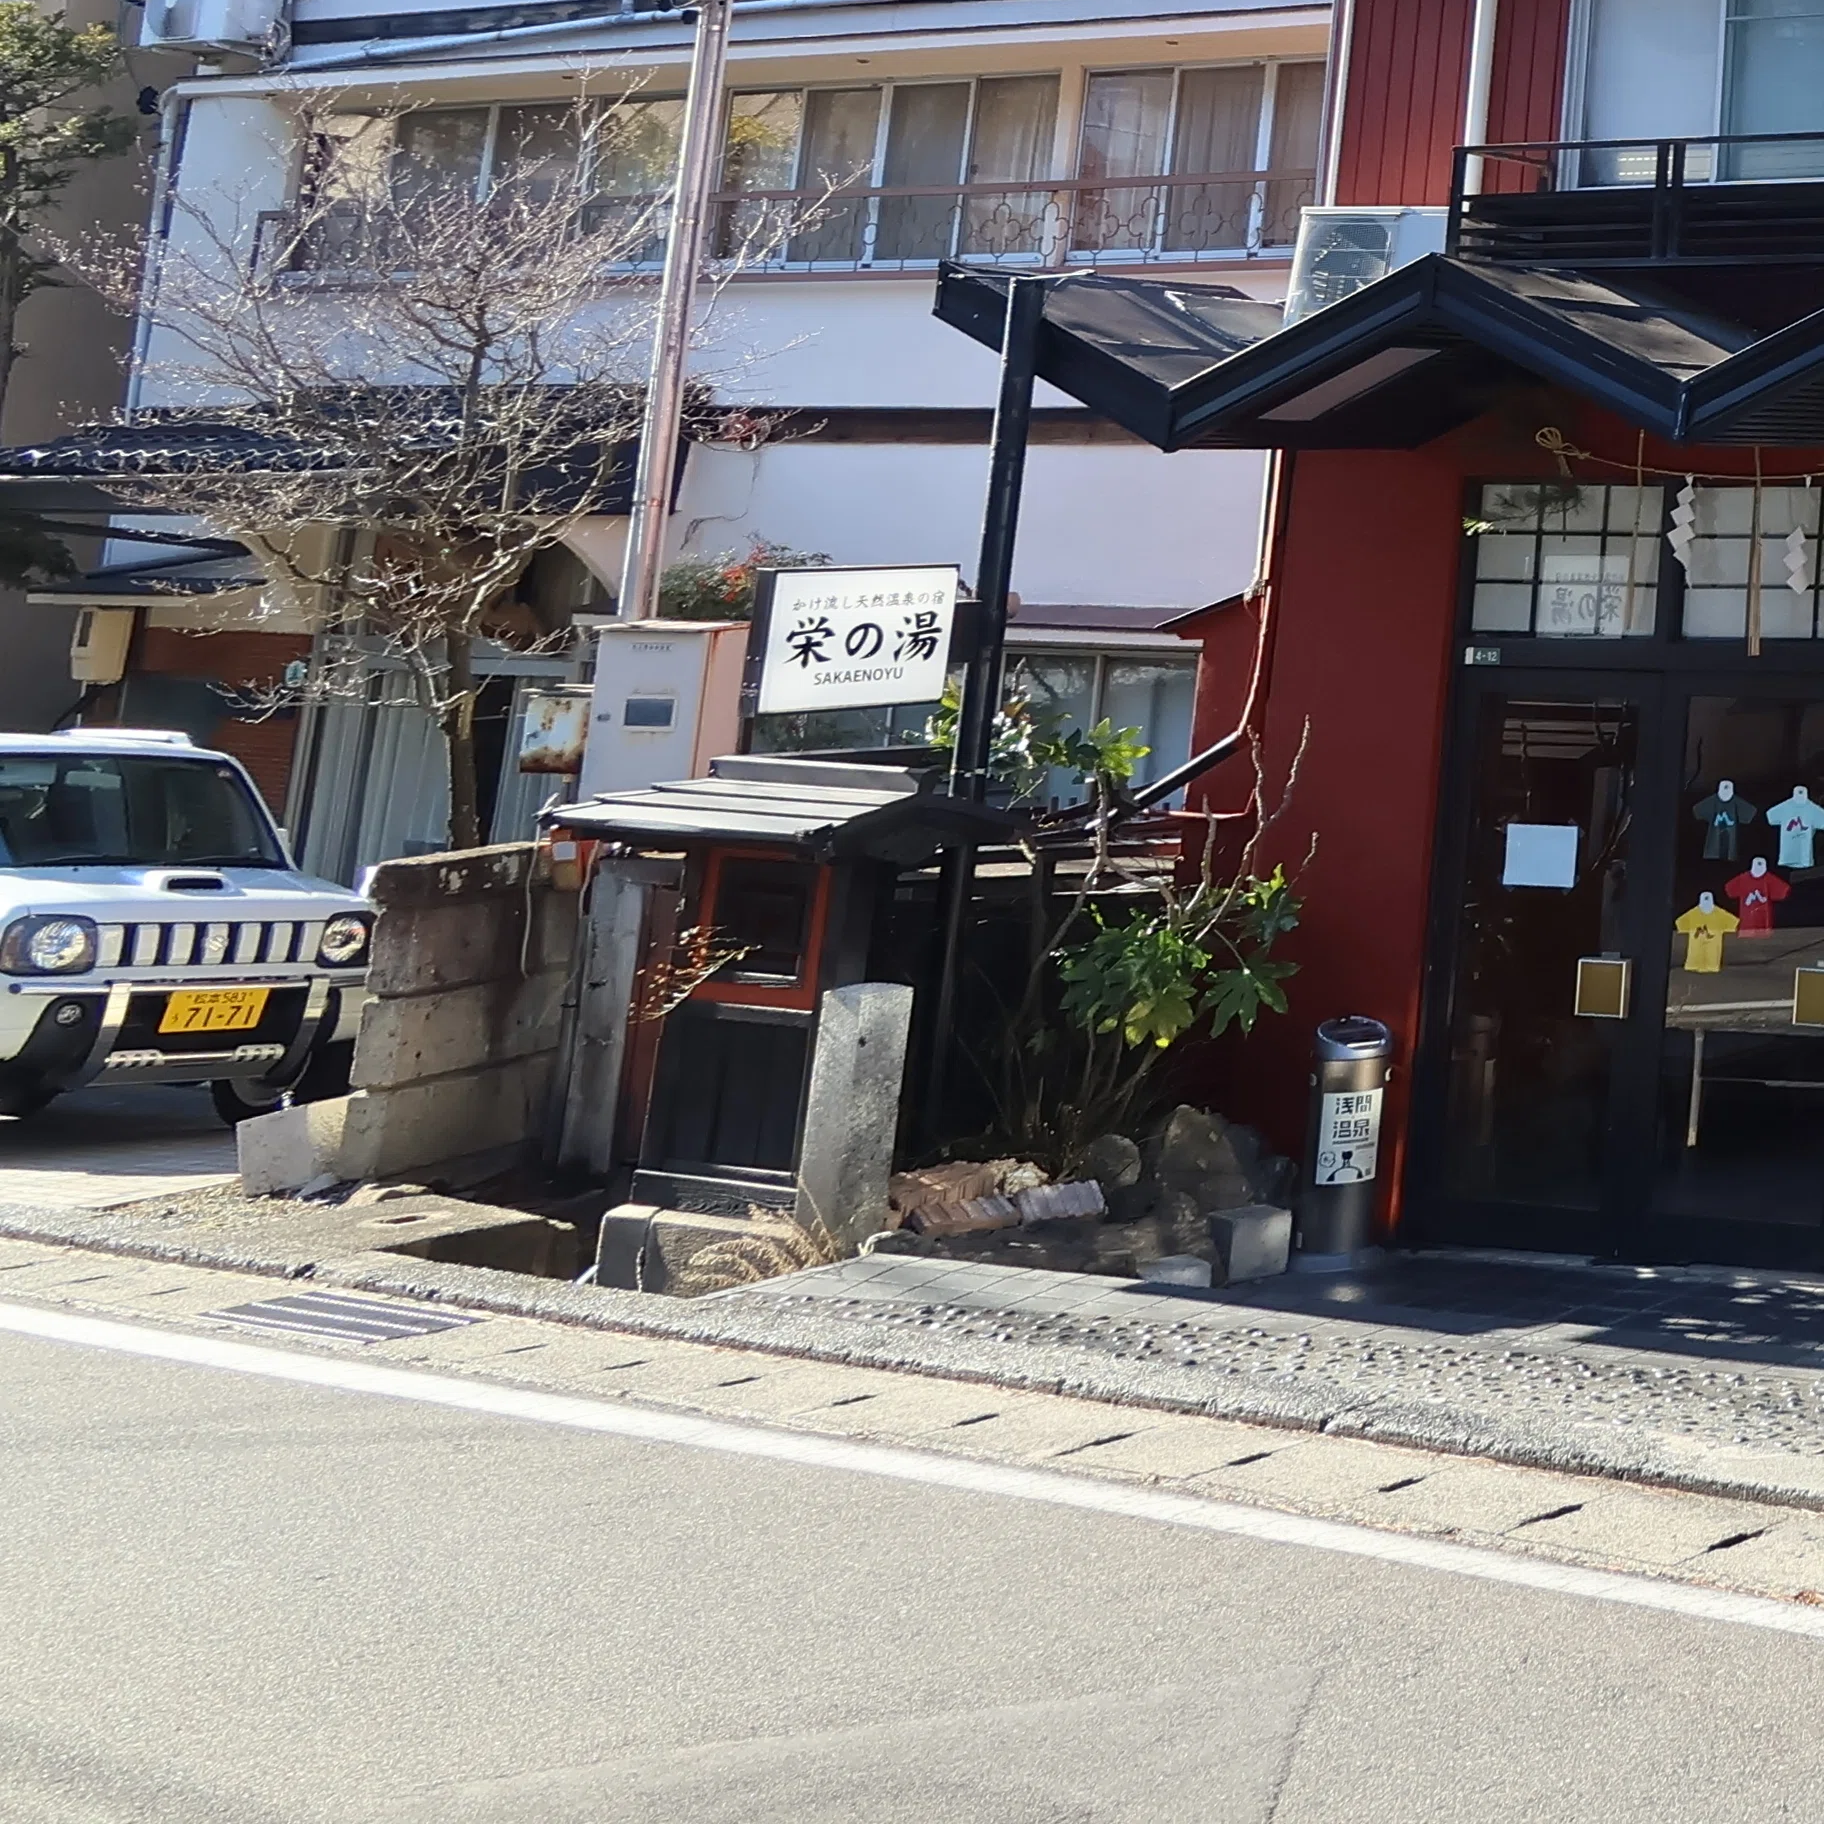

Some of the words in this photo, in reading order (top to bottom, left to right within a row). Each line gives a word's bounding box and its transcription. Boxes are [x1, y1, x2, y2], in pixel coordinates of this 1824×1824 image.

[792, 590, 945, 612] かけ流し天然温泉の宿
[784, 610, 943, 668] 栄の湯
[1475, 650, 1498, 662] 4-12
[813, 667, 903, 686] SAKAENOYU
[183, 1004, 255, 1028] 71-71
[1335, 1094, 1373, 1114] 浅間
[1332, 1119, 1370, 1138] 温泉
